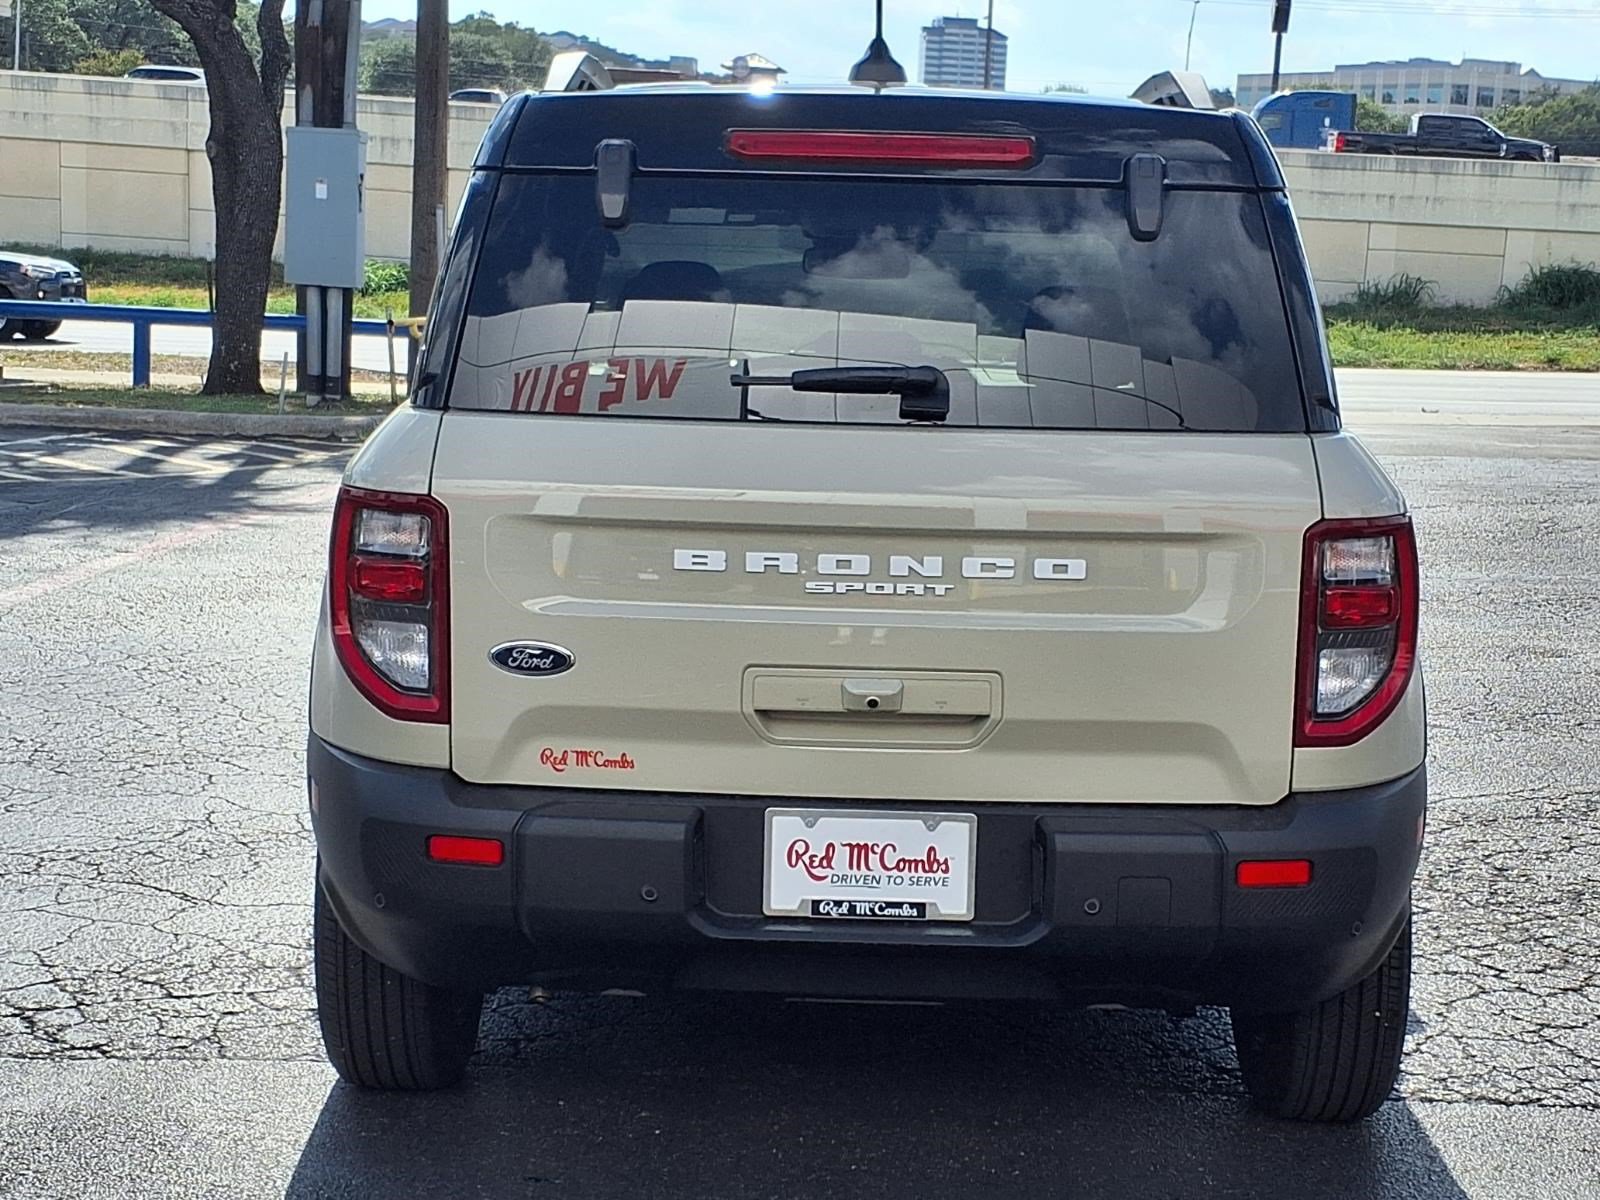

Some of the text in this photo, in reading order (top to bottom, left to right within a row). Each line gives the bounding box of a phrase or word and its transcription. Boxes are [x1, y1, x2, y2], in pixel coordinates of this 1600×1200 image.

[673, 549, 1087, 580] BRONCO
[805, 582, 955, 596] SPORT
[508, 648, 554, 668] Ford
[540, 747, 635, 772] Red McCombs
[786, 839, 950, 881] Red McCombs
[830, 874, 950, 887] DRIVEN TO SERVE
[819, 900, 918, 917] Red McCombs
